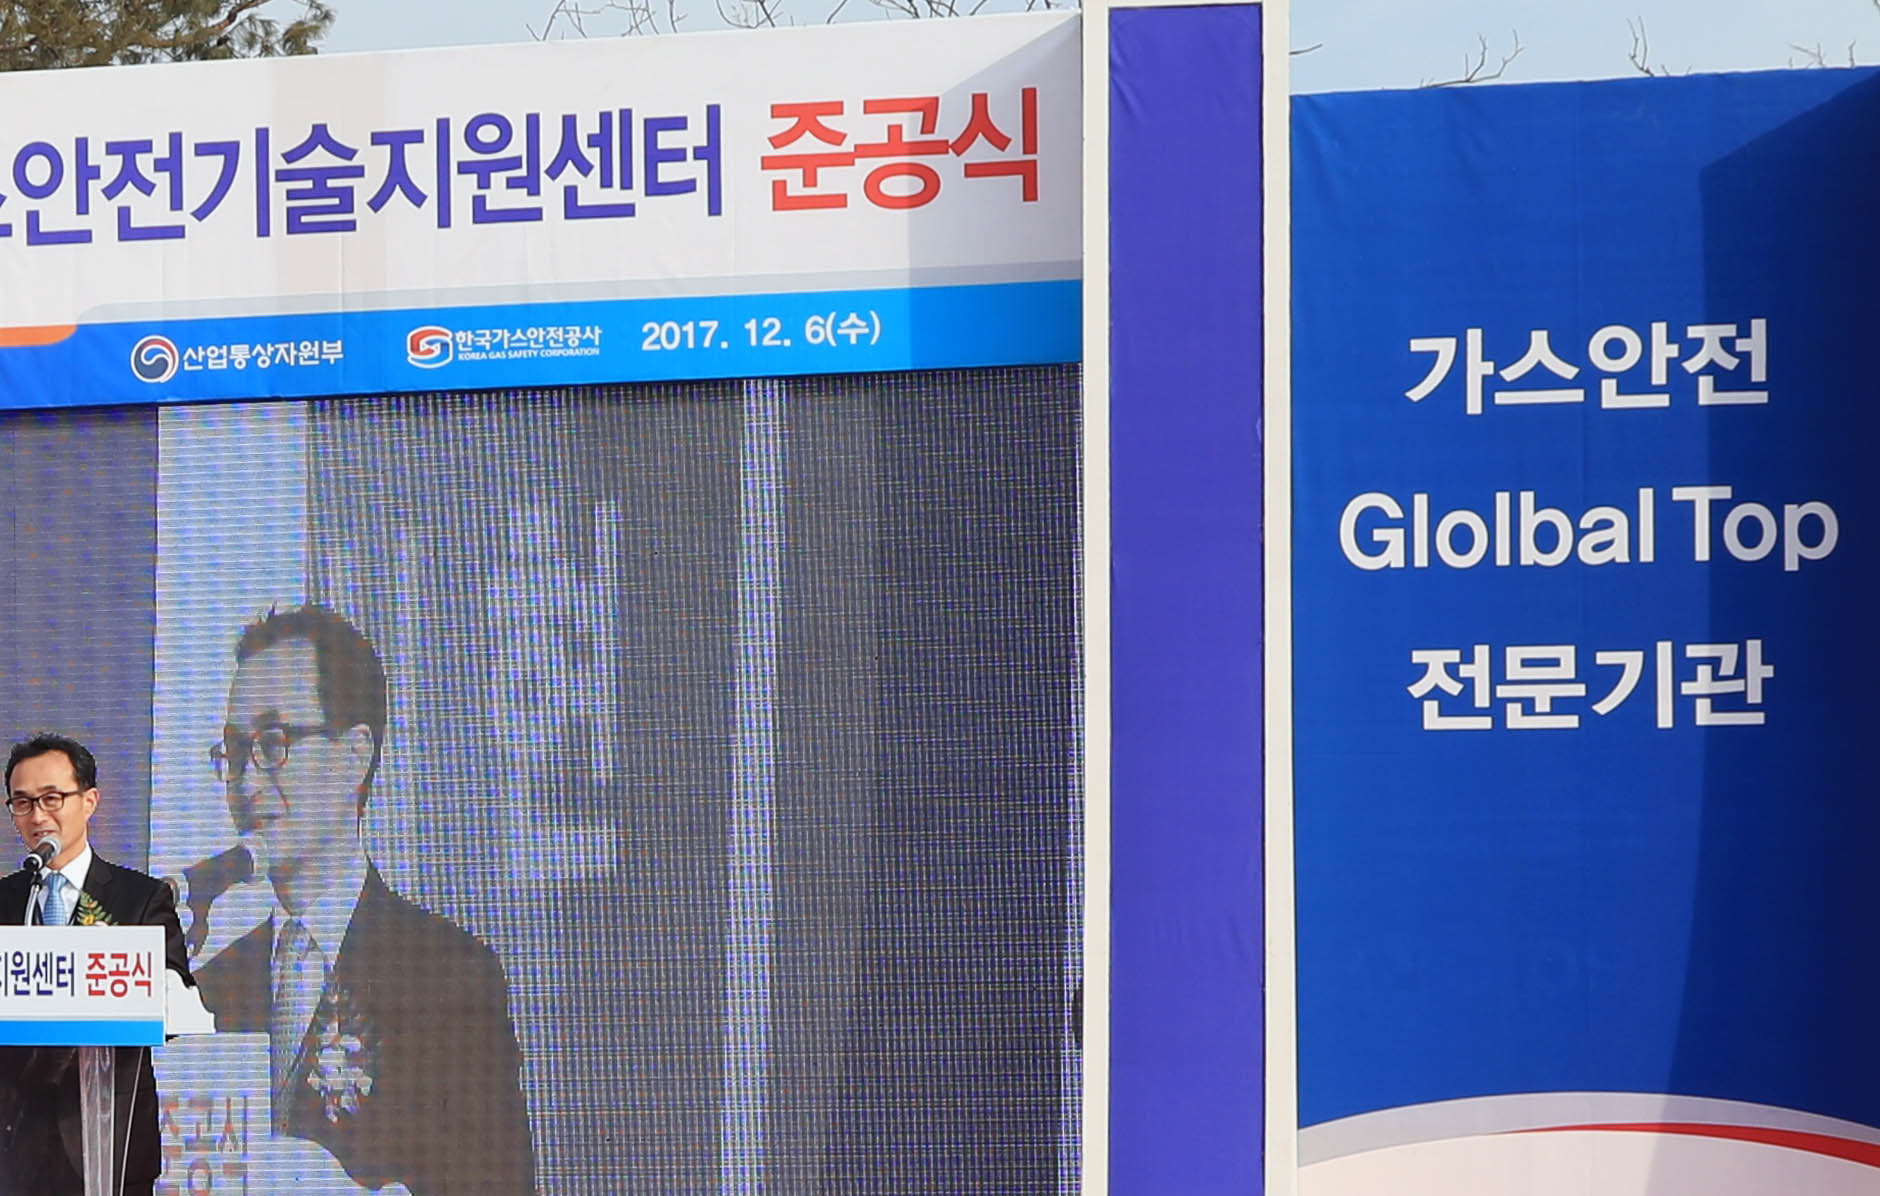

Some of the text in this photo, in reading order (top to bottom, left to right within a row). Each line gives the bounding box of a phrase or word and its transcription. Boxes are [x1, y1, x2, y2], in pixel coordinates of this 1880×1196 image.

[758, 86, 1041, 212] 준공식
[456, 325, 602, 351] 한국가스안전공사
[643, 310, 882, 350] 2017. 12. 6(수)
[183, 339, 345, 370] 산업통상자원부
[458, 347, 600, 361] KOREA GAS SAFETY CORPORATION
[1405, 318, 1769, 415] 가스안전
[1339, 485, 1839, 571] Glolbal Top
[1407, 639, 1775, 730] 전문기관
[85, 951, 153, 997] 준공식
